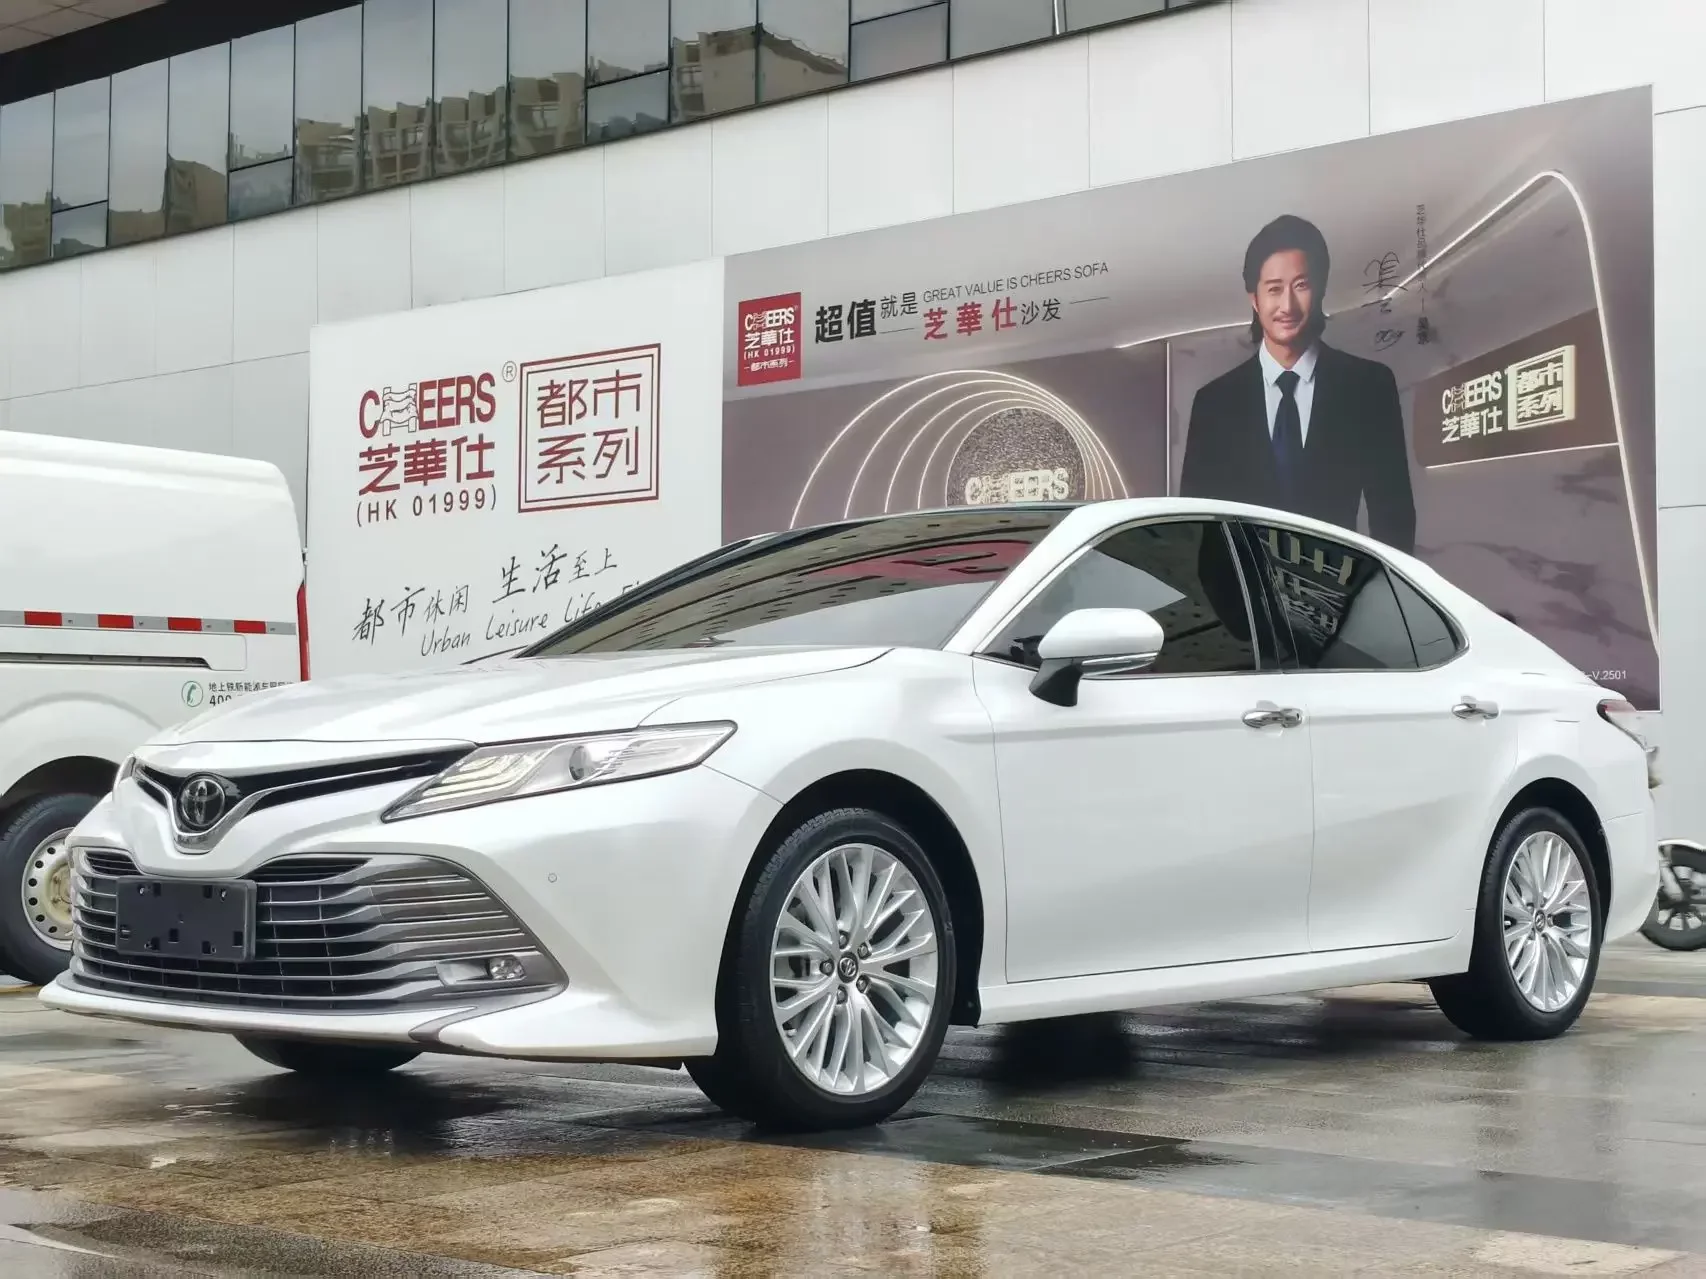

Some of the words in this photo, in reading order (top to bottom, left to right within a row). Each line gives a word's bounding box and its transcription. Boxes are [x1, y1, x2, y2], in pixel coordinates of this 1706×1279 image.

[923, 285, 962, 303] GREAT
[962, 279, 1003, 297] VALUE
[1006, 276, 1018, 291] IS
[1020, 267, 1072, 288] CHEERS
[1074, 262, 1109, 279] SOFA
[744, 327, 795, 350] 芝華仕
[745, 306, 795, 330] CHEERS
[763, 344, 796, 356] 01999)
[536, 368, 643, 430] 都市
[1442, 371, 1503, 414] CHEERS
[1516, 362, 1563, 395] 都市
[359, 372, 497, 438] CHEERS
[1516, 386, 1563, 419] 系列
[1442, 406, 1503, 444] 芝華仕
[358, 433, 496, 497] 芝華仕
[536, 425, 640, 485] 系列
[356, 498, 398, 528] (HK
[412, 484, 497, 517] 01999)
[352, 584, 470, 647] 都市休闲
[492, 543, 618, 604] 生活至上
[421, 626, 471, 657] Urban
[485, 607, 549, 641] Leisure
